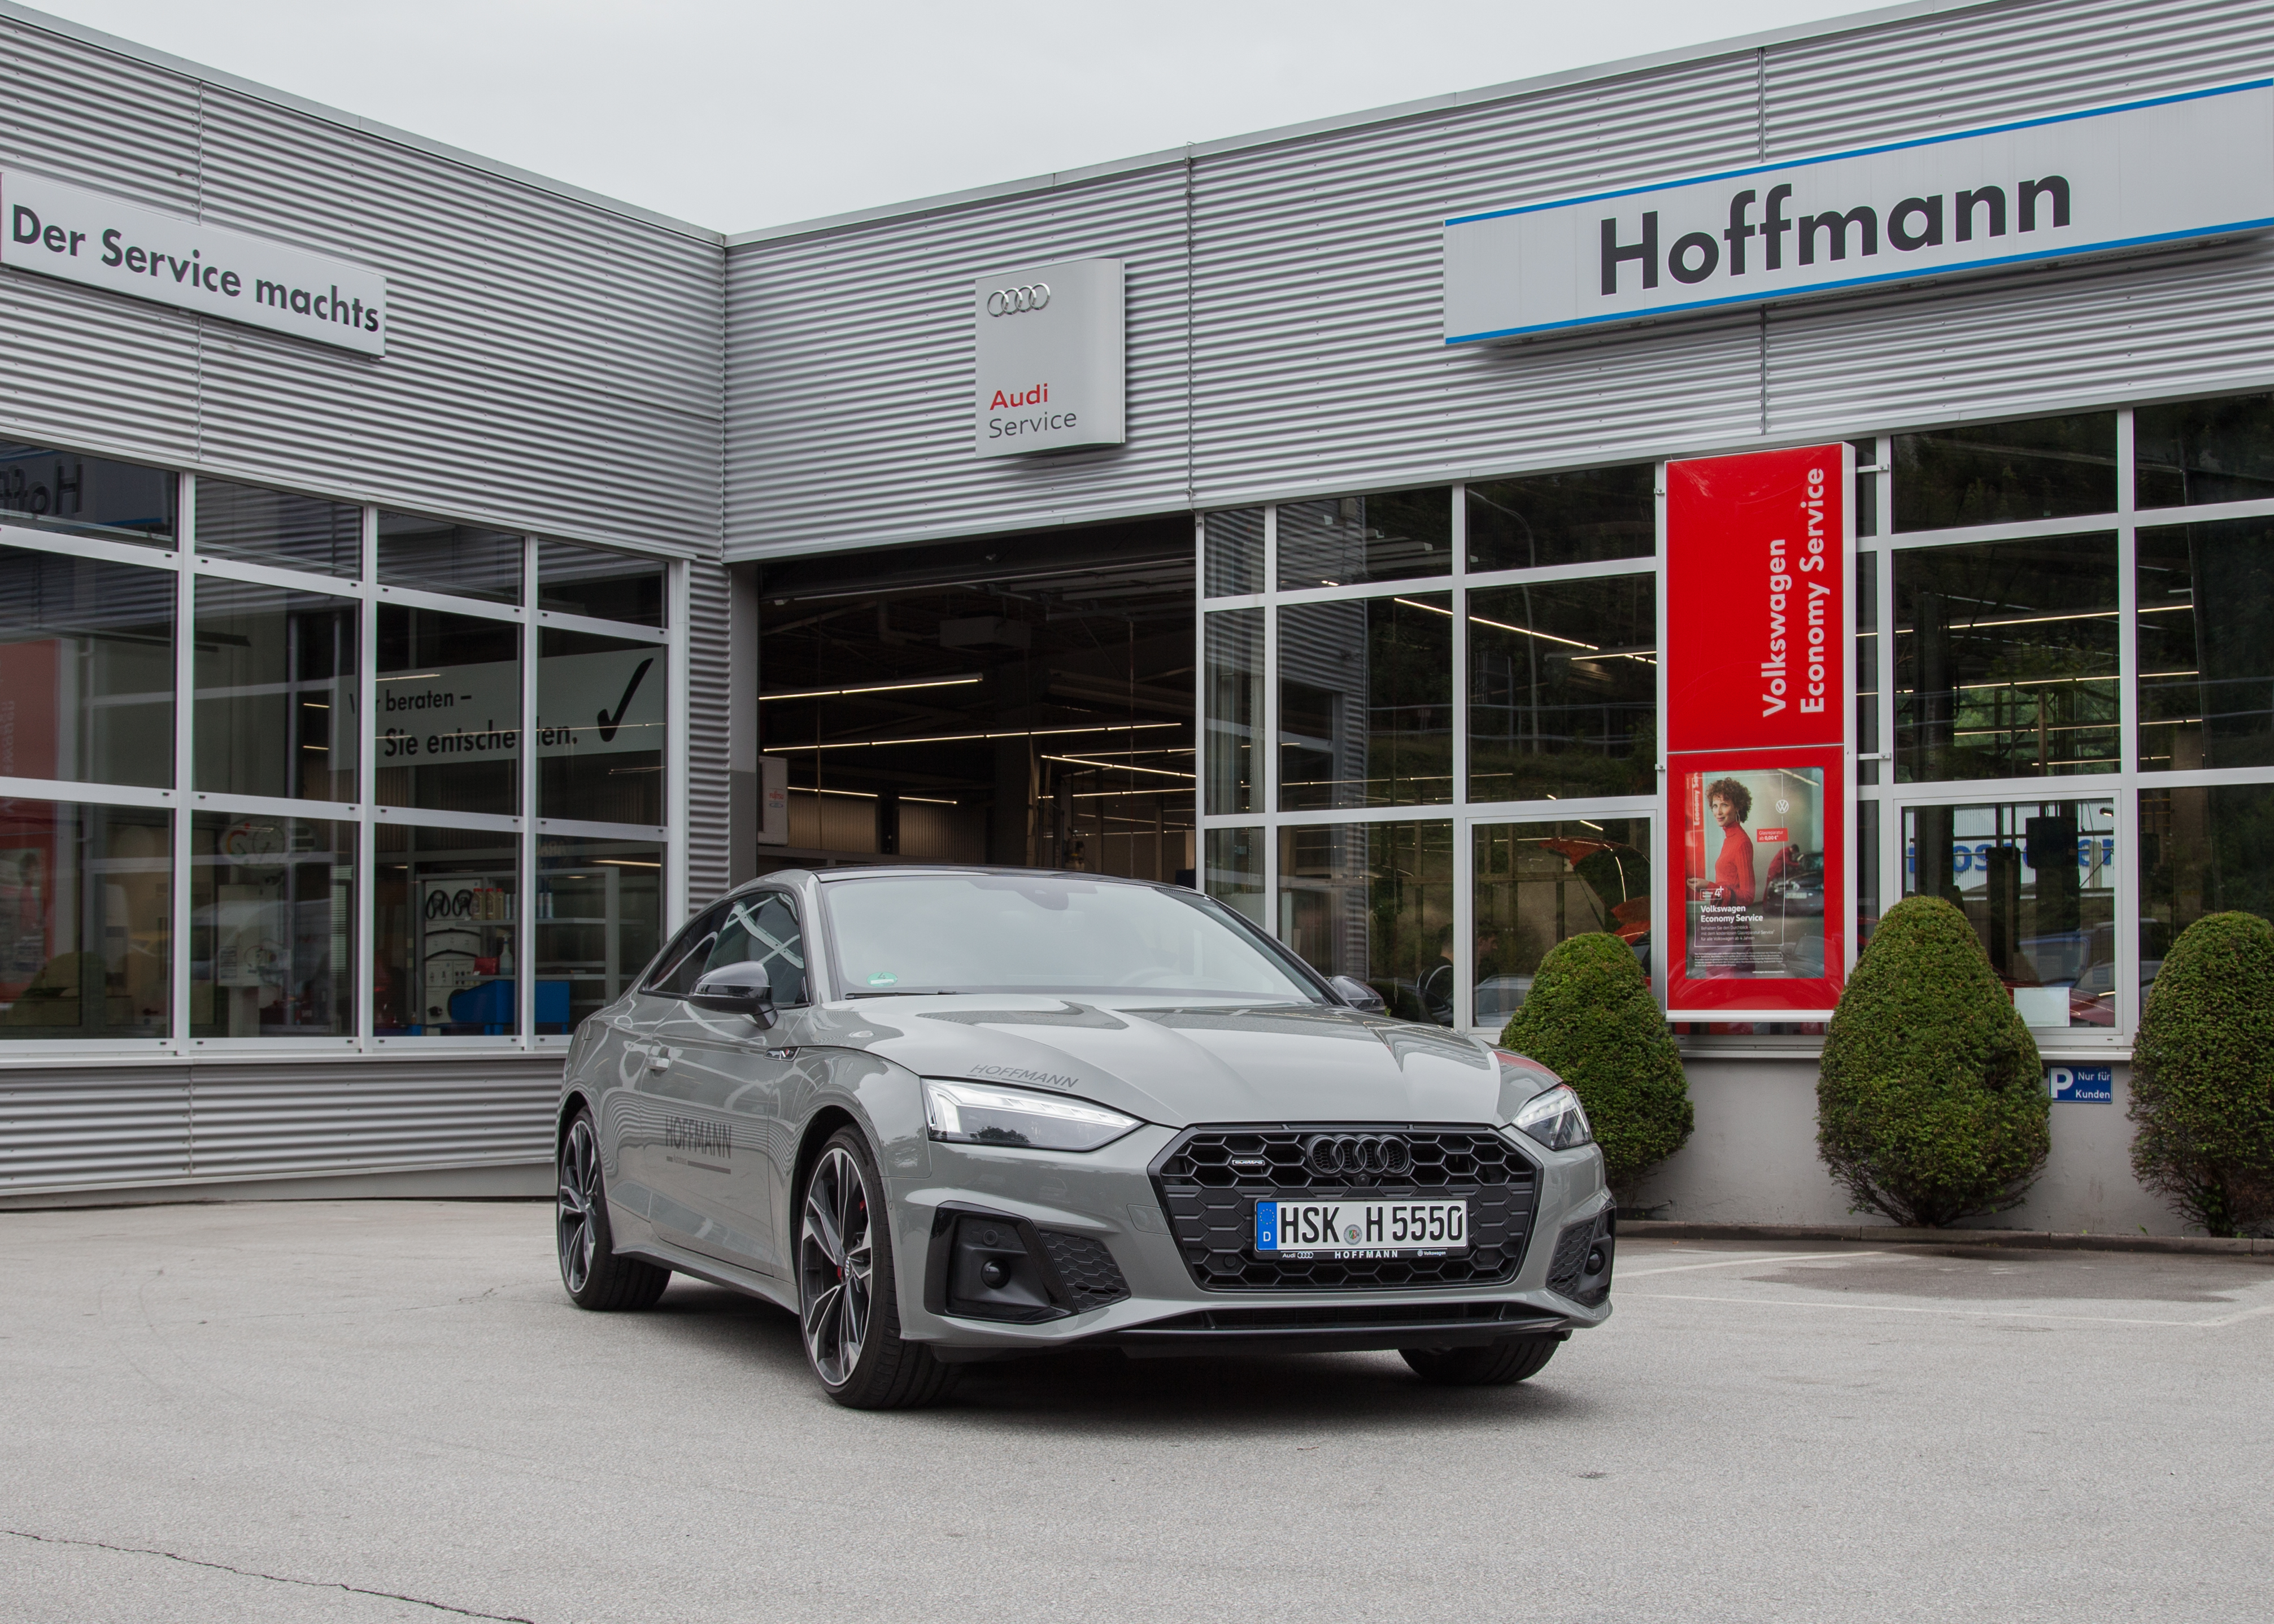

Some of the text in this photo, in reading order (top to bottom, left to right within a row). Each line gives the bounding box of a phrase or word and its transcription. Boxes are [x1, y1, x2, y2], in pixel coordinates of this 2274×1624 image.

[1601, 175, 2071, 295] Hoffmann
[13, 204, 379, 332] Der Service machts
[990, 383, 1048, 411] Audi
[989, 411, 1077, 438] Service
[1799, 468, 1830, 713] Economy Service
[1761, 539, 1792, 717] Volkswagen
[386, 689, 454, 712] beraten
[385, 716, 578, 757] Sie entscheen.
[1701, 905, 1746, 914] Volkswagen
[970, 1064, 1079, 1088] HOFFMANN
[2050, 1067, 2073, 1098] P
[2078, 1072, 2110, 1081] Nur für
[2076, 1089, 2110, 1099] Kunden
[666, 1115, 731, 1159] HOFFMANN
[1263, 1232, 1271, 1242] D
[1281, 1207, 1340, 1243] HSK
[1366, 1206, 1383, 1242] H
[1392, 1206, 1462, 1241] 5550
[1335, 1250, 1398, 1259] HOFFMANN
